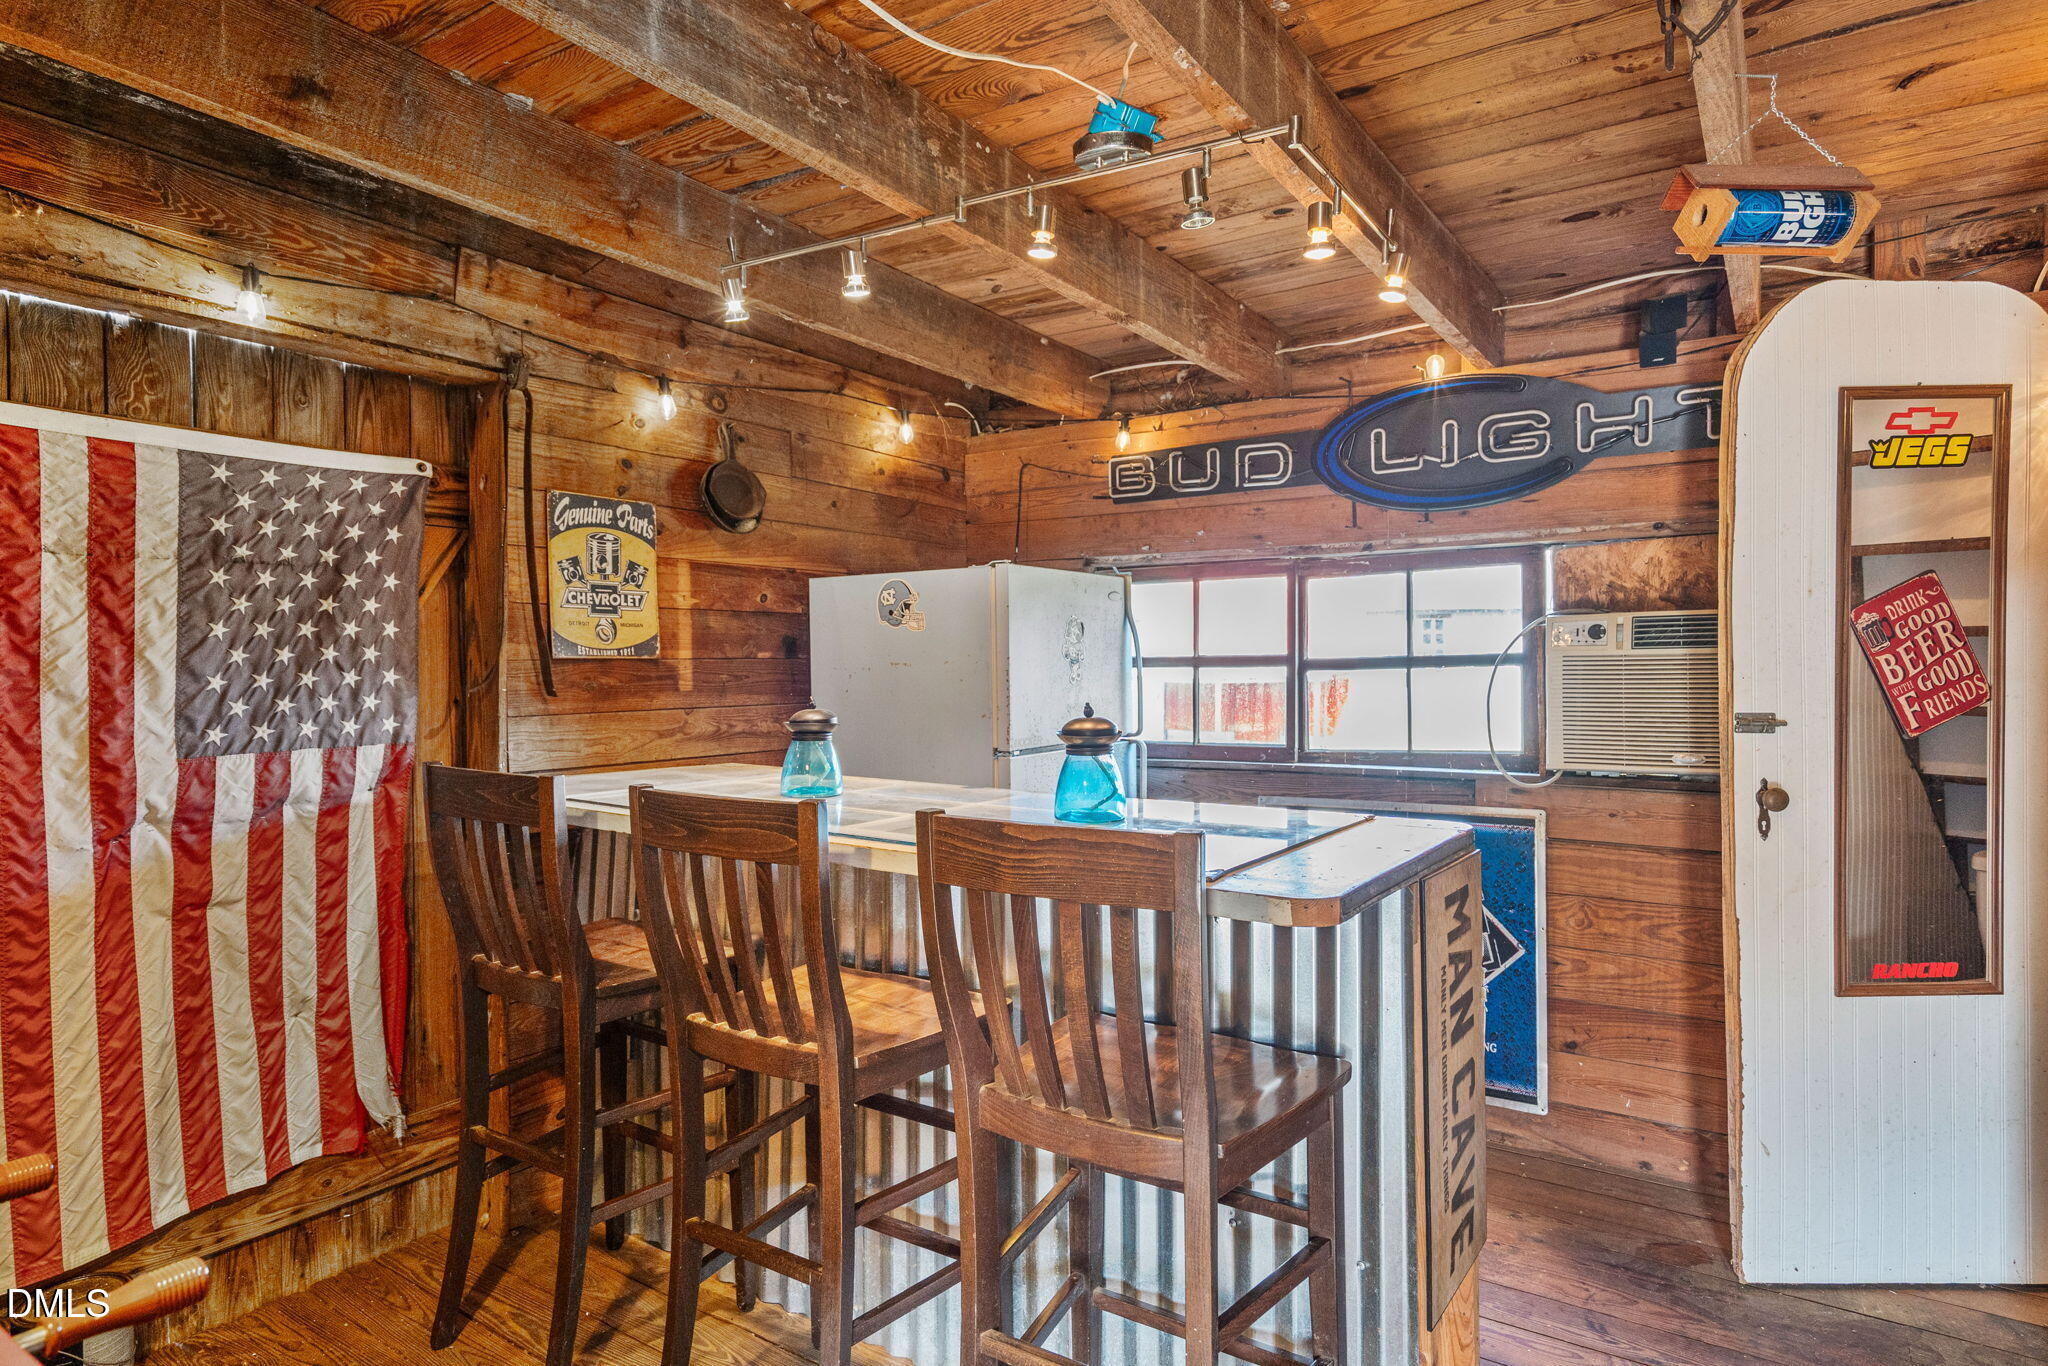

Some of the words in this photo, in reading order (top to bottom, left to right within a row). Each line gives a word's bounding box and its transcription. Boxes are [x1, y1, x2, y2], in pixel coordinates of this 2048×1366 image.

[1784, 191, 1826, 247] LIGH
[1108, 441, 1293, 499] BUD
[1370, 385, 1723, 475] LIGHT
[1869, 433, 1974, 469] JEGS
[554, 497, 613, 531] Genuine
[615, 503, 654, 540] Parts
[567, 591, 642, 607] CHEVROLET
[1884, 588, 1929, 621] DRINK
[1894, 601, 1952, 640] GOOD
[577, 645, 618, 656] ESTABLISHED
[1875, 620, 1966, 686] BEER
[1890, 680, 1915, 697] WITH
[1917, 649, 1976, 693] GOOD
[1897, 673, 1988, 730] FRIENDS
[1444, 883, 1474, 1048] MAN
[1871, 962, 1959, 979] RANCHO
[1442, 1157, 1450, 1214] THINGS
[1450, 1056, 1475, 1278] CAVE
